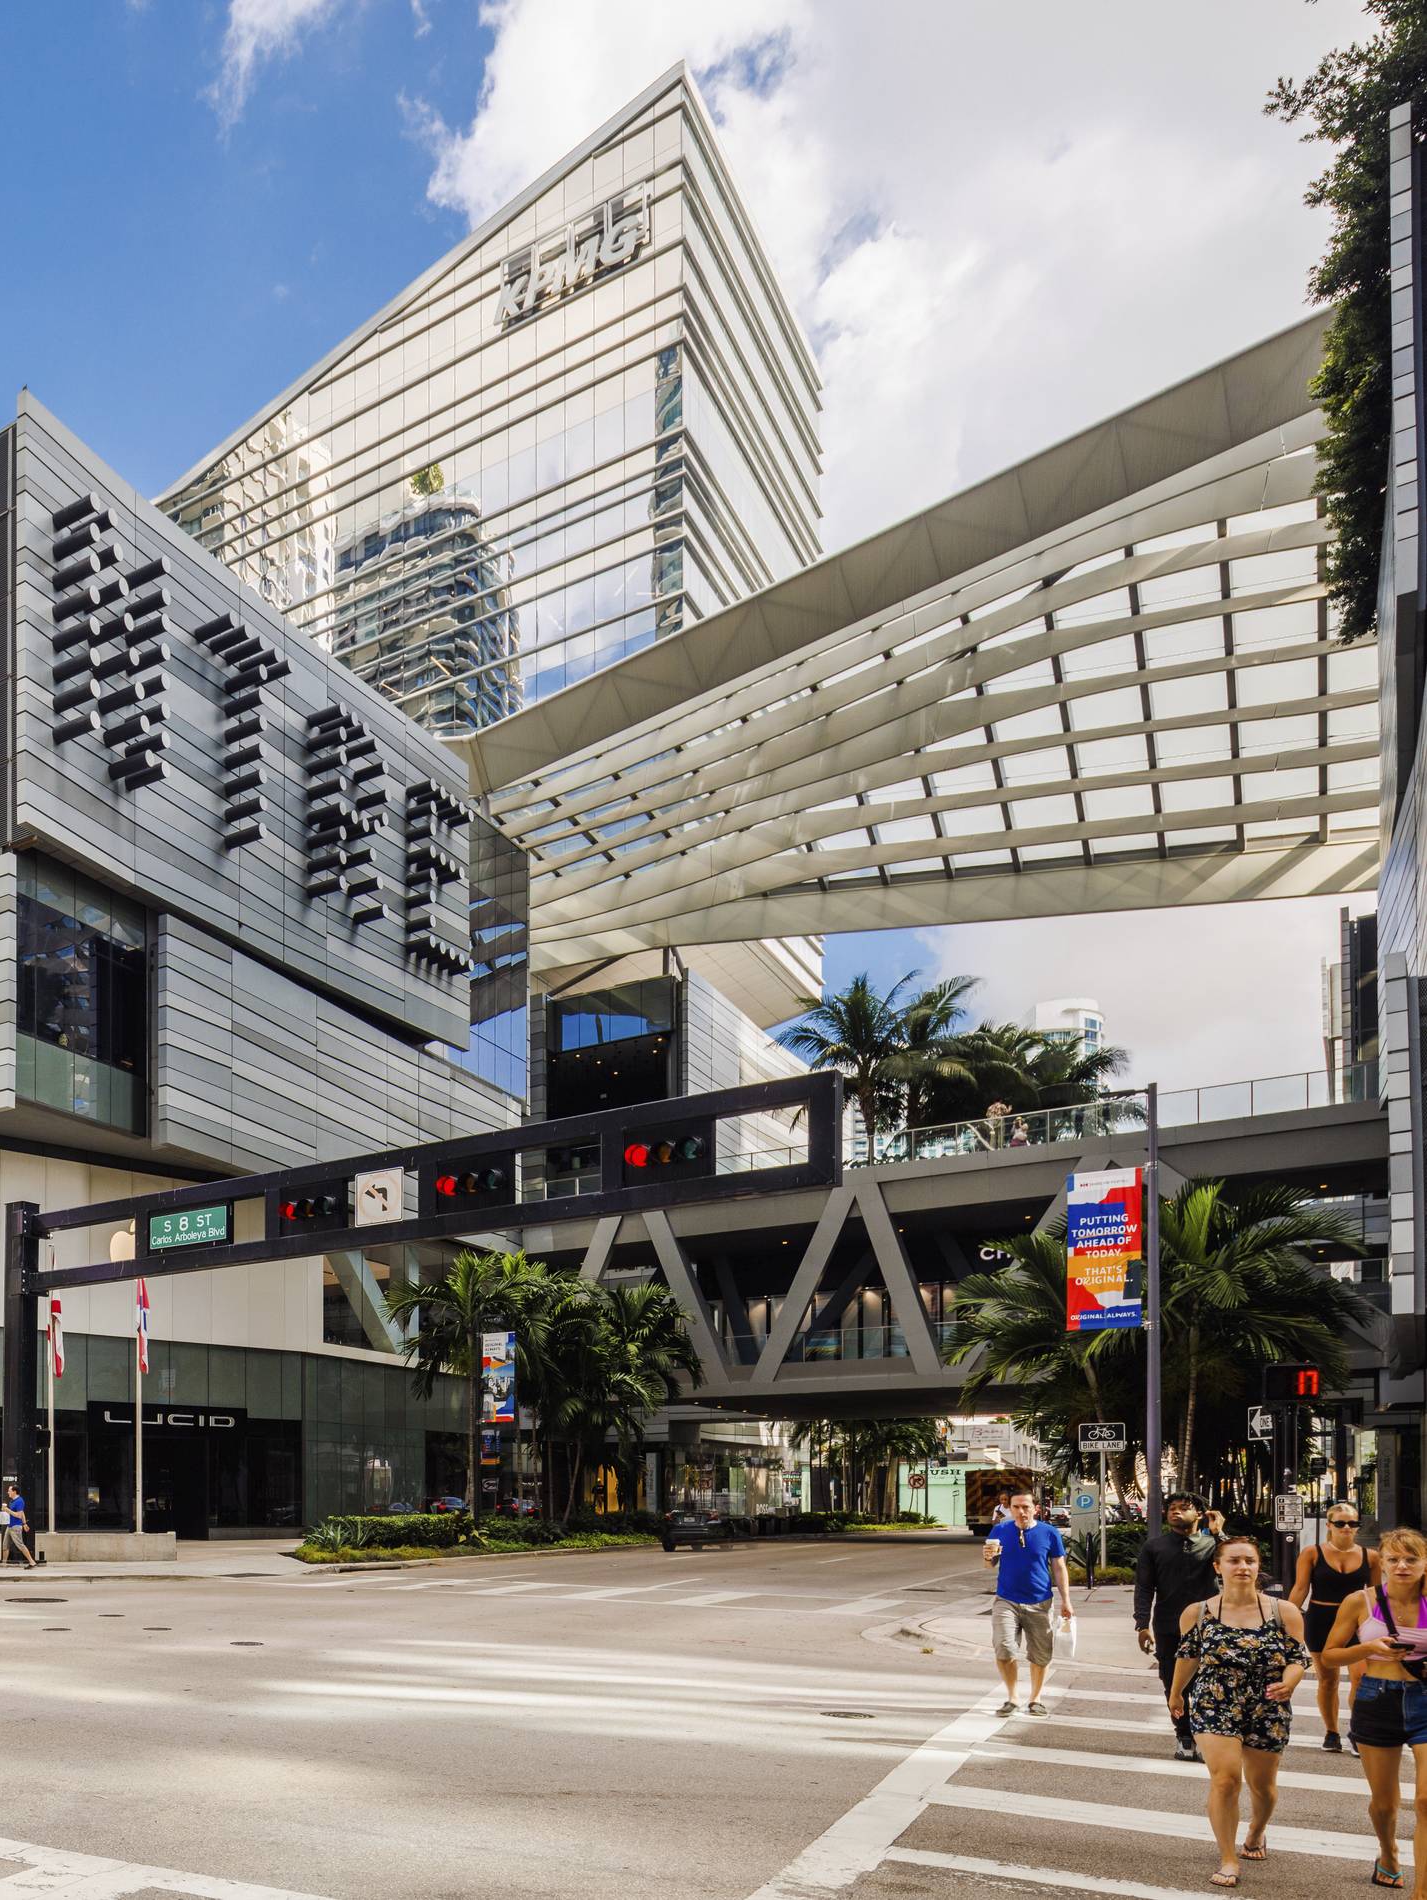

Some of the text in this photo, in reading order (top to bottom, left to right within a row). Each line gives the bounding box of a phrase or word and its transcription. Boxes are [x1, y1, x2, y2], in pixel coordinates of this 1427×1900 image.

[493, 213, 641, 326] KPMG
[164, 1213, 212, 1232] S 8 ST
[1080, 1213, 1129, 1226] PUTTING
[151, 1226, 225, 1245] Carlos Arboleya Blvd
[1071, 1224, 1138, 1238] TOMORROW
[1076, 1236, 1132, 1249] AHEAD OF
[1086, 1248, 1123, 1259] TODAY.
[1086, 1265, 1123, 1276] THAT'S
[1075, 1273, 1134, 1286] ORIGINAL.
[1070, 1311, 1138, 1321] ORIGINAL. ALWAYS.
[1298, 1371, 1318, 1395] 17
[104, 1410, 236, 1428] LUCID
[1260, 1416, 1271, 1428] ONE
[1102, 1441, 1122, 1449] LANE
[1081, 1496, 1091, 1507] P
